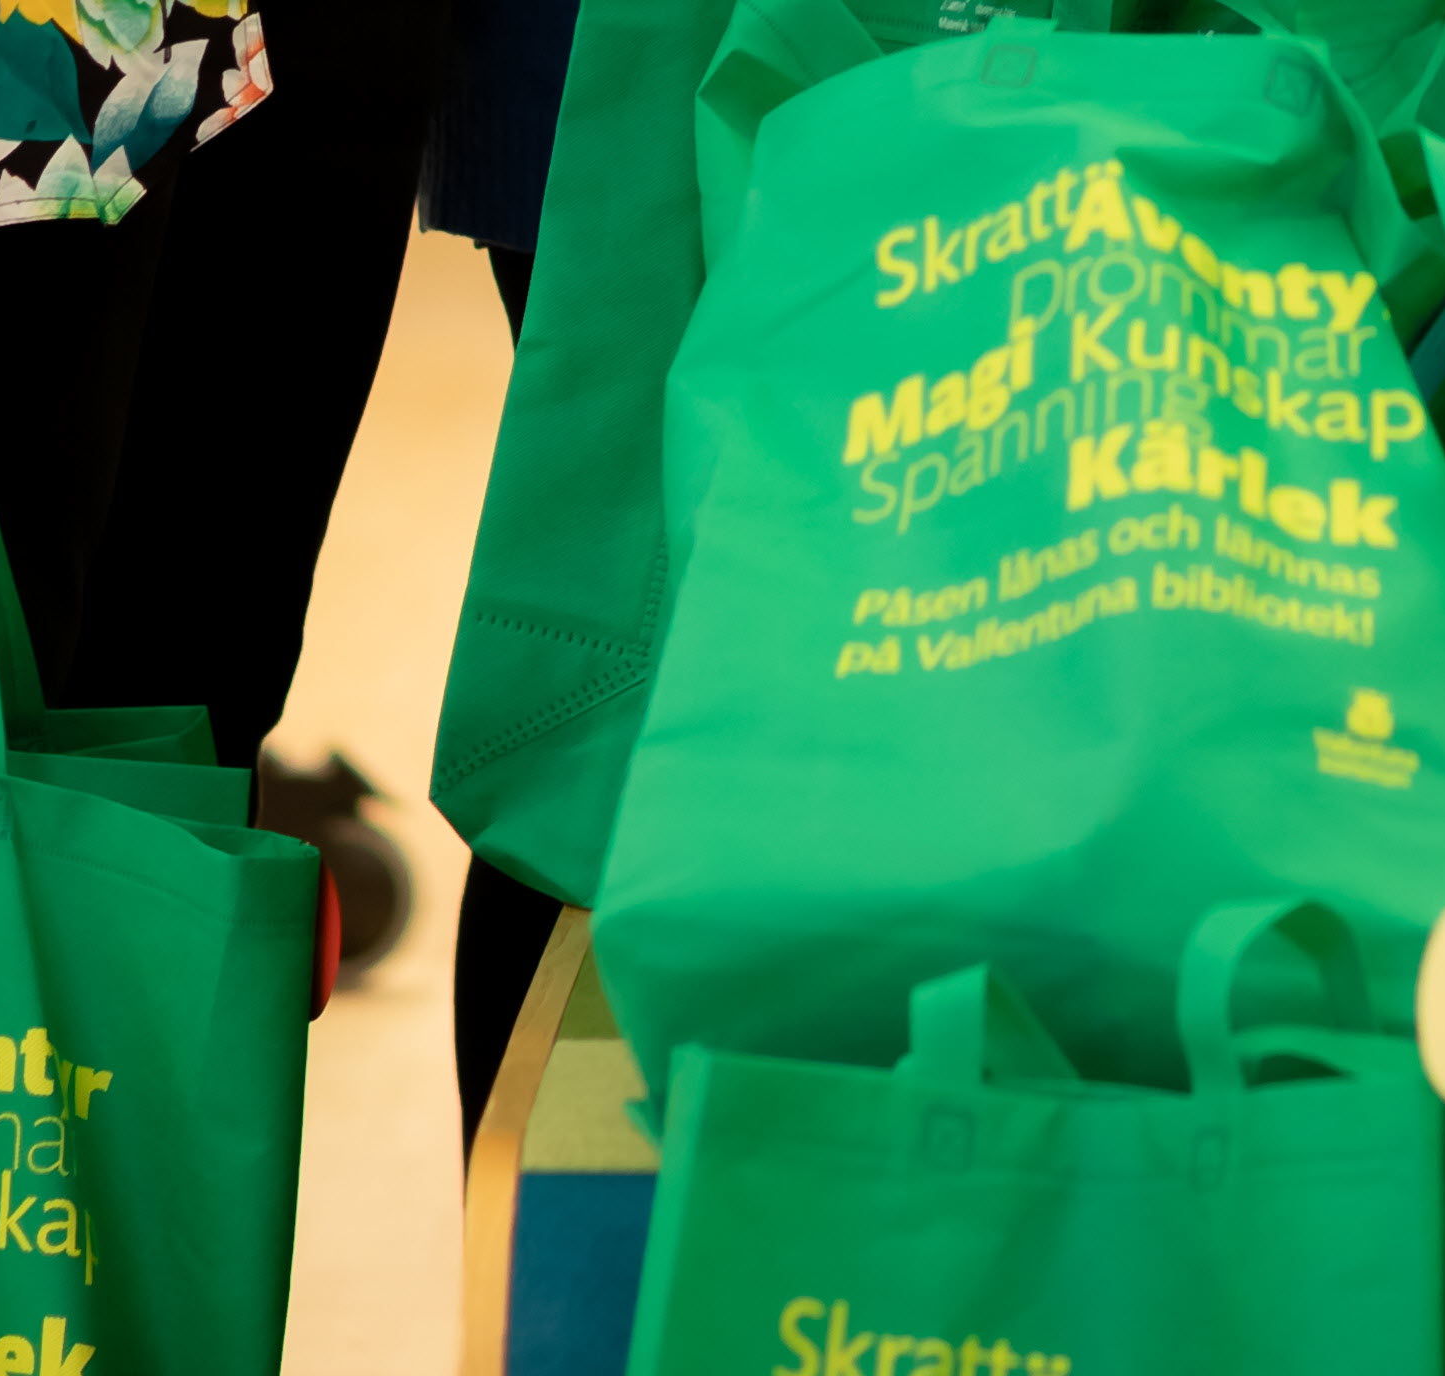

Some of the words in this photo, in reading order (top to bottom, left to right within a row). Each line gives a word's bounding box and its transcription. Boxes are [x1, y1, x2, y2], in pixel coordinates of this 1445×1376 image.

[875, 168, 1078, 308] Skratt
[1064, 159, 1391, 333] Äventy
[843, 315, 1034, 465] Magi
[1070, 303, 1426, 461] Kunskap
[1066, 418, 1399, 548] Kärlek
[835, 636, 902, 679] på
[917, 576, 1138, 671] Vallentuna
[1153, 562, 1375, 648] bibliotek!
[853, 576, 988, 627] Påsen
[1108, 503, 1200, 555] och
[1214, 513, 1381, 599] lämnas
